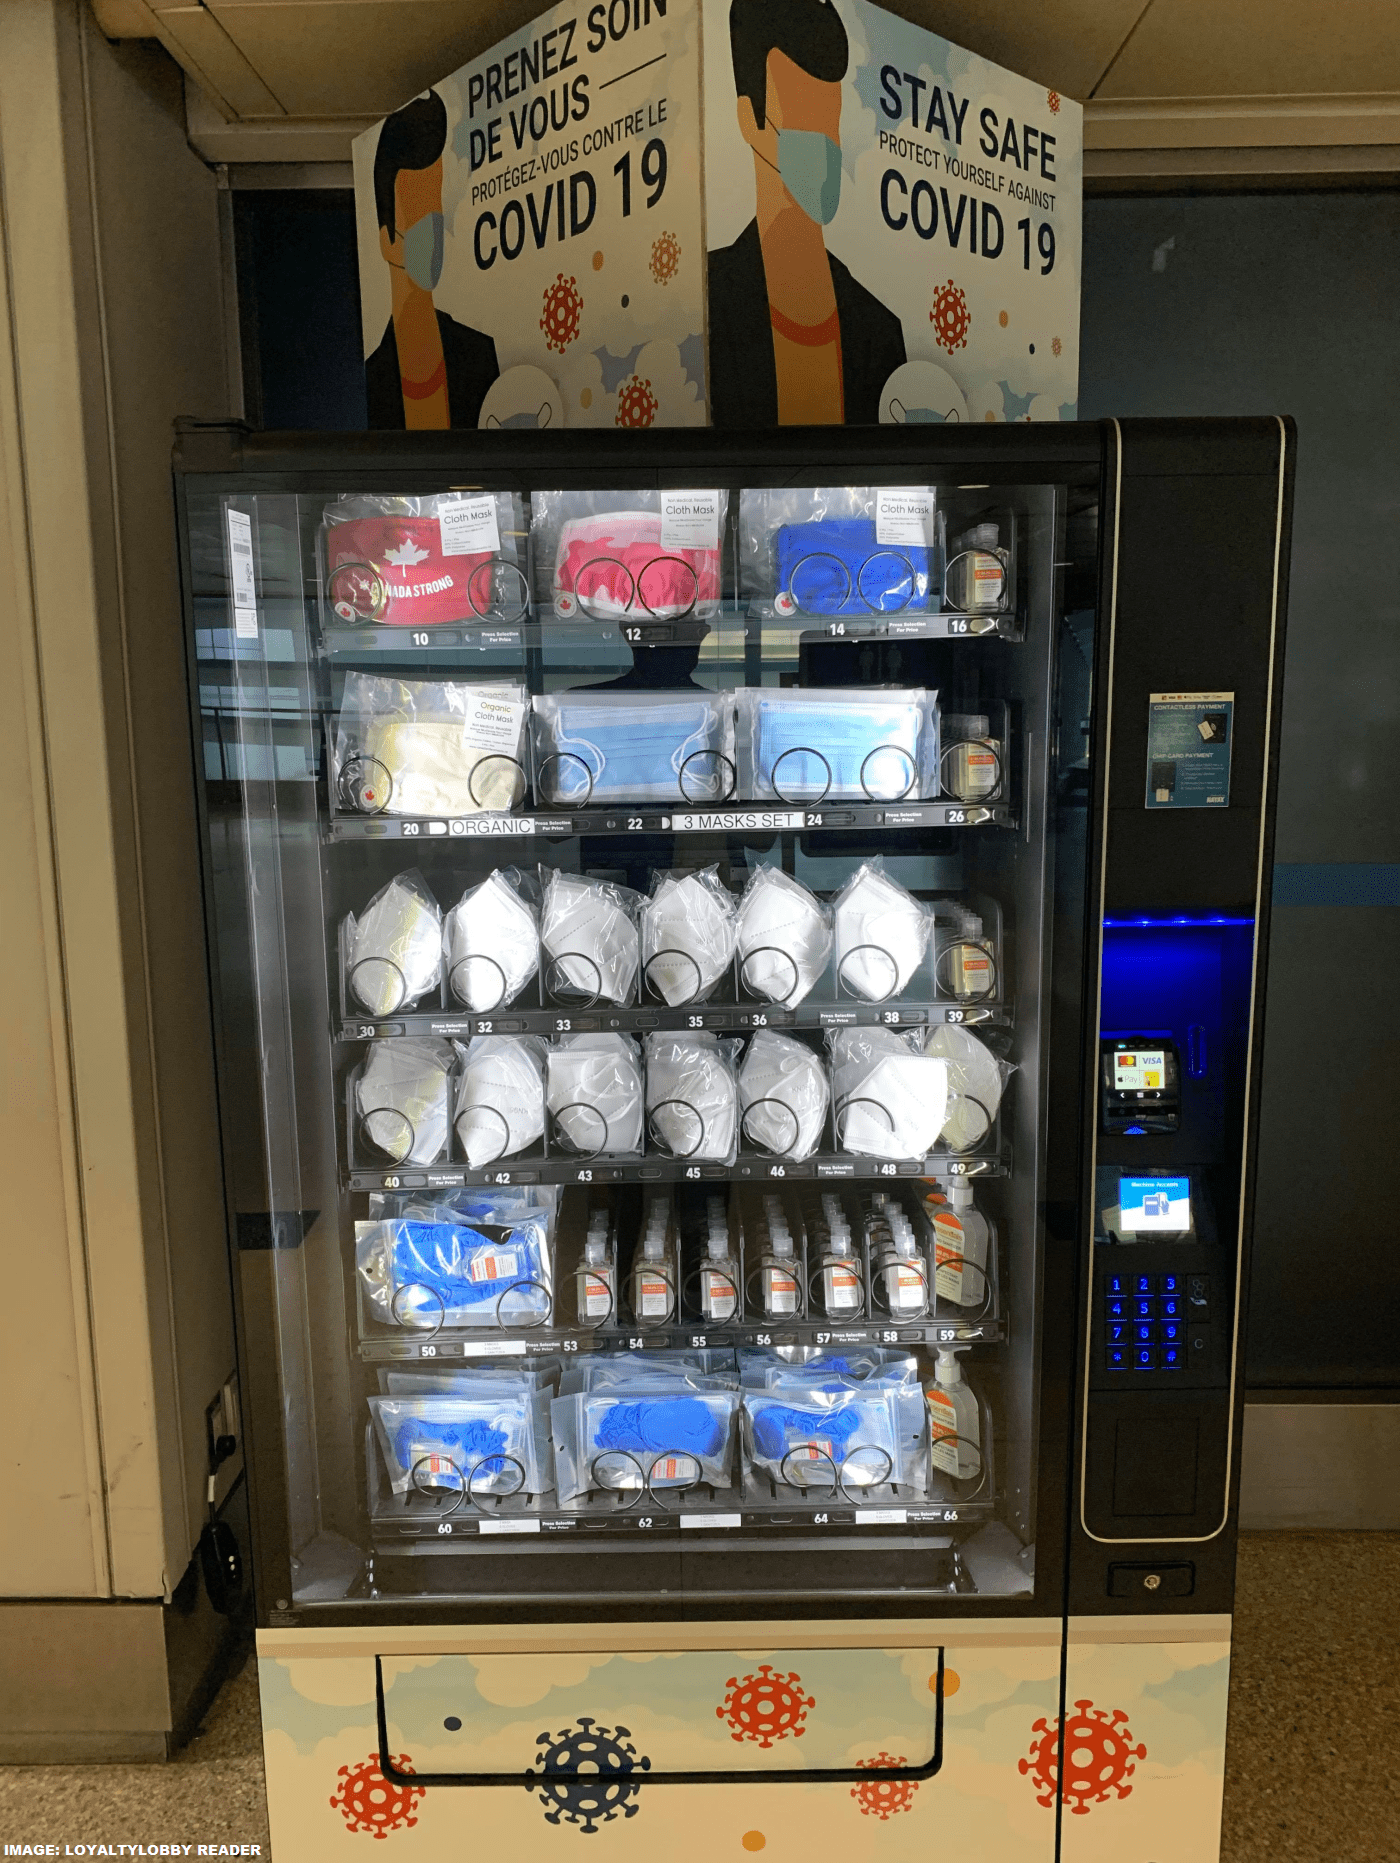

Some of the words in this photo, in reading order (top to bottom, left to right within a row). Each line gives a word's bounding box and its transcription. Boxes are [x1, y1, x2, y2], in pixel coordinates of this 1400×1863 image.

[468, 19, 578, 119] PRENEZ
[587, 0, 666, 53] SOIN
[470, 117, 502, 171] DE
[510, 74, 590, 150] VOUS
[879, 64, 970, 146] STAY
[979, 107, 1056, 182] SAFE
[471, 139, 579, 206] PROTÉGEZ-VOUS
[582, 108, 645, 156] CONTRE
[648, 98, 667, 127] LE
[879, 130, 939, 170] PROTECT
[943, 154, 1005, 193] YOURSELF
[1007, 177, 1056, 212] AGAINST
[473, 170, 597, 270] COVID
[613, 137, 668, 218] 19
[880, 168, 1004, 260] COVID
[1017, 216, 1056, 275] 19
[666, 505, 690, 514] Cloth
[693, 504, 714, 514] Mask
[880, 504, 906, 514] Cloth
[908, 505, 930, 514] Mask
[444, 512, 468, 524] Cloth
[470, 510, 492, 520] Mask
[413, 575, 454, 597] STRONG
[830, 623, 845, 636] 14
[952, 620, 967, 632] 16
[413, 633, 429, 645] 10
[626, 628, 641, 640] 12
[481, 702, 511, 712] Organic
[475, 712, 495, 720] Cloth
[496, 715, 514, 723] Mask
[684, 816, 693, 829] 3
[699, 815, 756, 828] MASKS
[762, 814, 794, 827] SET
[807, 814, 822, 826] 24
[949, 811, 964, 822] 26
[403, 823, 419, 835] 20
[452, 820, 531, 834] ORGANIC
[627, 818, 643, 830] 22
[688, 1016, 703, 1028] 35
[752, 1015, 767, 1026] 36
[884, 1012, 899, 1023] 38
[948, 1011, 963, 1022] 39
[360, 1026, 375, 1036] 30
[477, 1022, 493, 1033] 32
[556, 1020, 571, 1031] 33
[1124, 1075, 1137, 1084] Pay
[686, 1167, 700, 1178] 45
[770, 1166, 785, 1177] 46
[881, 1164, 896, 1175] 48
[951, 1163, 965, 1174] 49
[496, 1173, 510, 1184] 42
[577, 1171, 593, 1182] 43
[384, 1177, 399, 1188] 40
[1113, 1280, 1120, 1290] 1
[1140, 1279, 1148, 1290] 2
[1168, 1279, 1175, 1290] 3
[1112, 1304, 1121, 1314] 4
[1141, 1303, 1148, 1314] 5
[1168, 1303, 1175, 1313] 6
[816, 1333, 830, 1343] 57
[883, 1331, 898, 1342] 58
[940, 1330, 954, 1341] 59
[1114, 1327, 1121, 1338] 7
[1141, 1328, 1149, 1338] 8
[1168, 1327, 1176, 1338] 9
[629, 1339, 643, 1349] 54
[692, 1336, 706, 1347] 55
[757, 1335, 771, 1345] 56
[1195, 1339, 1203, 1349] C
[421, 1346, 436, 1356] 50
[564, 1341, 578, 1351] 53
[1142, 1352, 1149, 1363] 0
[814, 1514, 828, 1524] 64
[944, 1511, 958, 1521] 66
[639, 1518, 652, 1528] 62
[438, 1524, 452, 1534] 60
